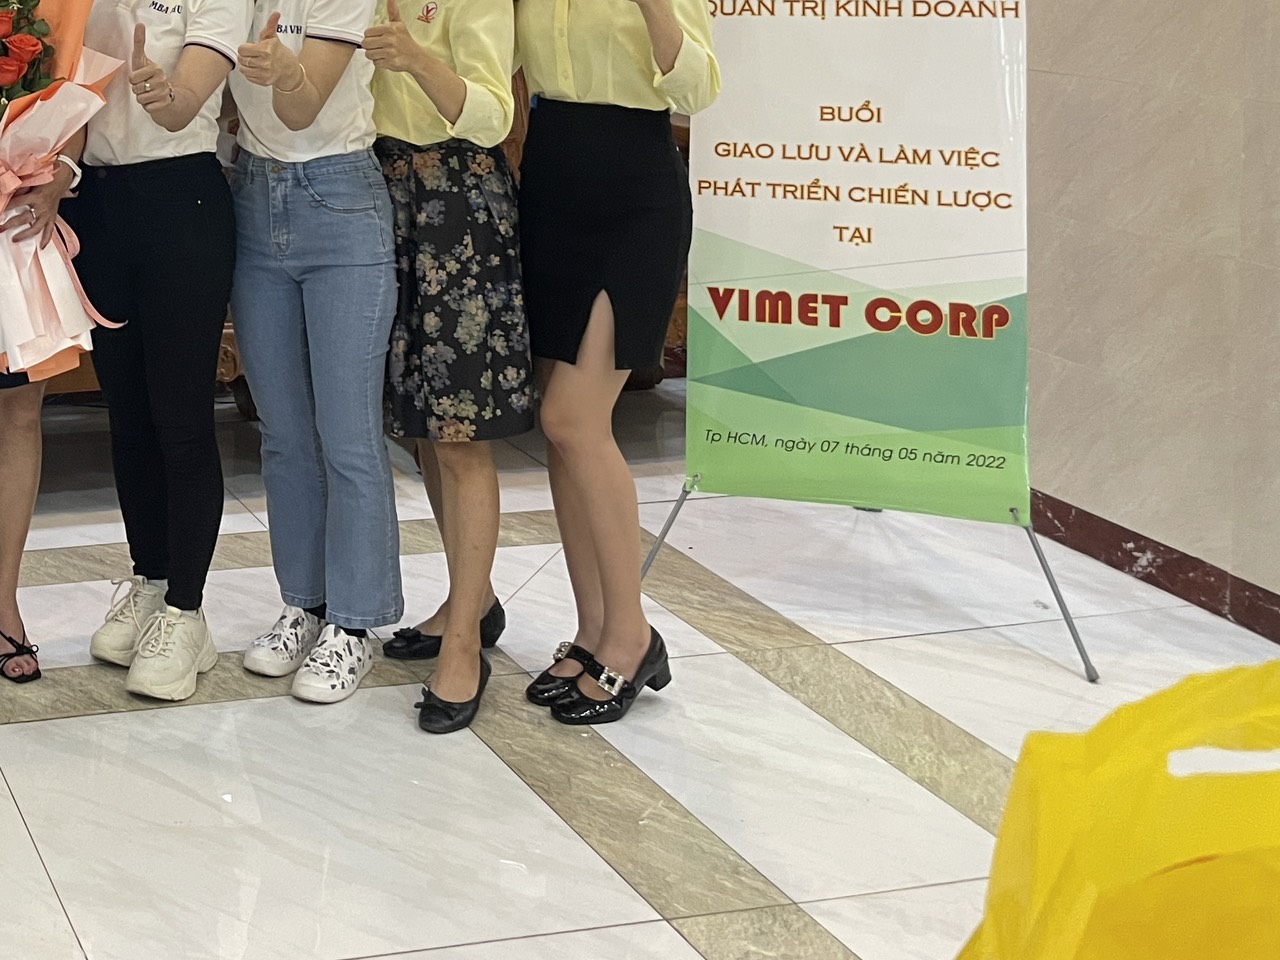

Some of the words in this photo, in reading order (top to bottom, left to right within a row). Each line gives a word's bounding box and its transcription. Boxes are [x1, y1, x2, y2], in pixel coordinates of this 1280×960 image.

[149, 0, 169, 14] MBA
[783, 0, 826, 20] TRỊ
[835, 0, 903, 17] KINH
[912, 0, 1020, 18] DOANH
[276, 24, 288, 33] BA
[290, 25, 302, 34] VH
[819, 100, 882, 123] BUỔI
[714, 142, 774, 159] GIAO
[782, 143, 831, 161] LƯU
[838, 143, 873, 163] VÀ
[878, 144, 932, 165] LÀM
[938, 146, 1000, 170] VIỆC
[697, 178, 761, 198] PHÁT
[766, 178, 841, 202] TRIỂN
[848, 183, 929, 206] CHIẾN
[937, 189, 1013, 211] LƯỢC
[833, 225, 873, 246] TẠI
[706, 286, 849, 328] VIMET
[864, 296, 1011, 339] CORP
[705, 429, 722, 444] Tp
[727, 431, 768, 447] HCM,
[774, 438, 817, 453] ngày
[820, 440, 840, 453] 07
[844, 442, 893, 461] tháng
[898, 447, 918, 461] 05
[922, 451, 961, 465] năm
[965, 453, 1006, 469] 2022
